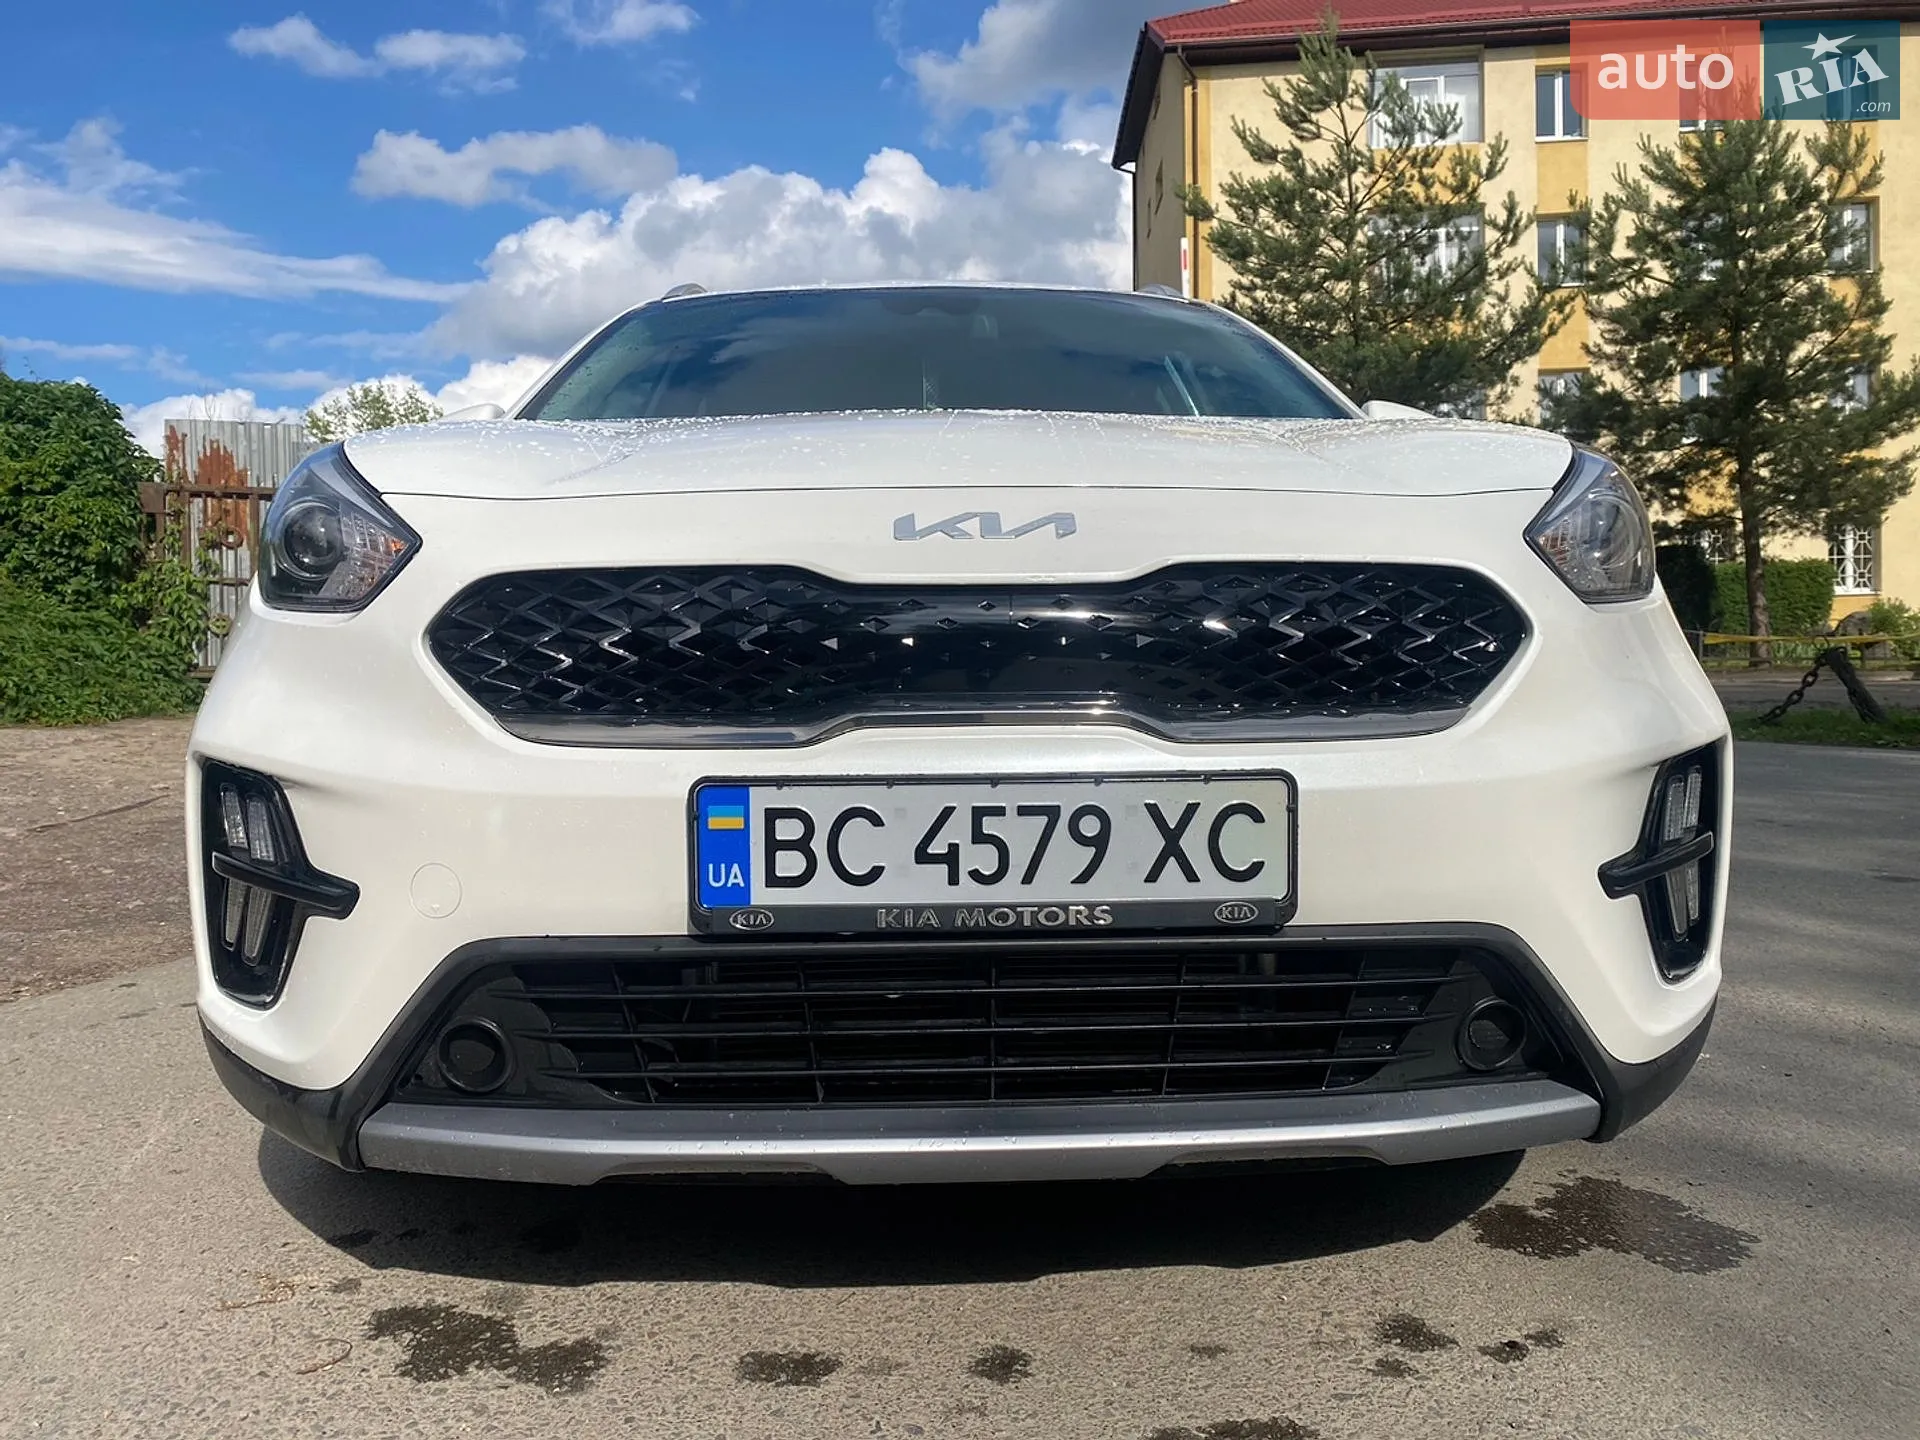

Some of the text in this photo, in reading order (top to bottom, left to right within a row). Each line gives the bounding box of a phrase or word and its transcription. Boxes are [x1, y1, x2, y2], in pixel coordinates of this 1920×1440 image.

[763, 801, 1265, 888] BC 4579 XC
[708, 863, 745, 888] UA
[876, 904, 1114, 929] KIA MOTORS
